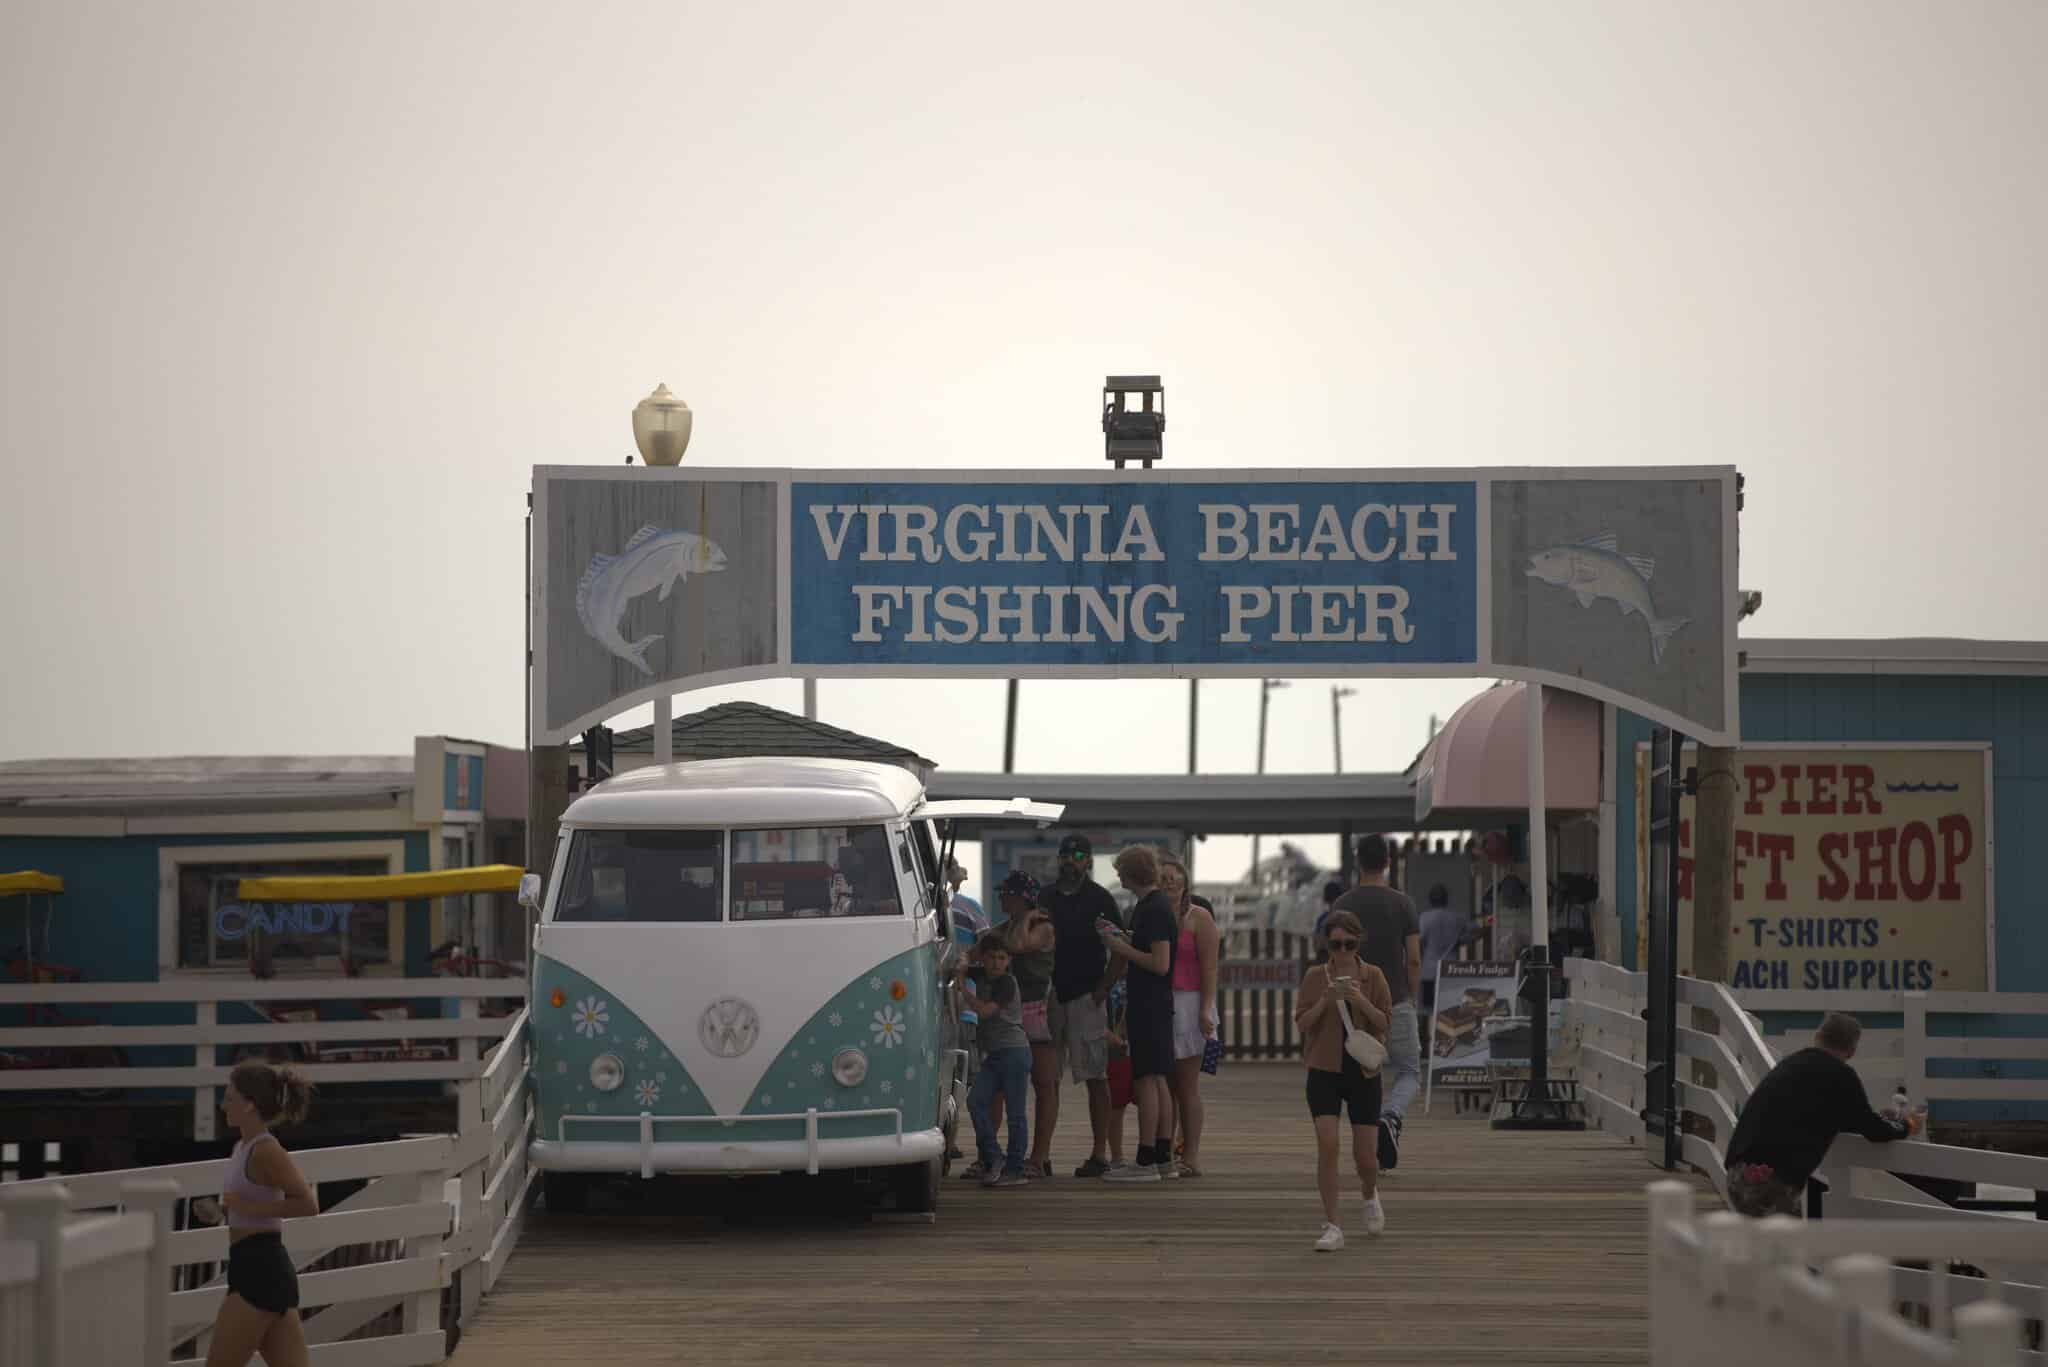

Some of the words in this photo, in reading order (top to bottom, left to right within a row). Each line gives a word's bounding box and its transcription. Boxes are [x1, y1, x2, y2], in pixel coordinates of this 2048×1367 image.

[809, 503, 1166, 564] VIRGINIA
[1198, 503, 1457, 563] BEACH
[851, 584, 1185, 645] FISHING
[1220, 585, 1416, 645] PIER
[1743, 764, 1883, 816] PIER
[1817, 813, 1973, 902] SHOP
[1748, 917, 1880, 949] T-SHIRTS
[1732, 959, 1790, 991] ACH
[1803, 959, 1934, 991] SUPPLIES
